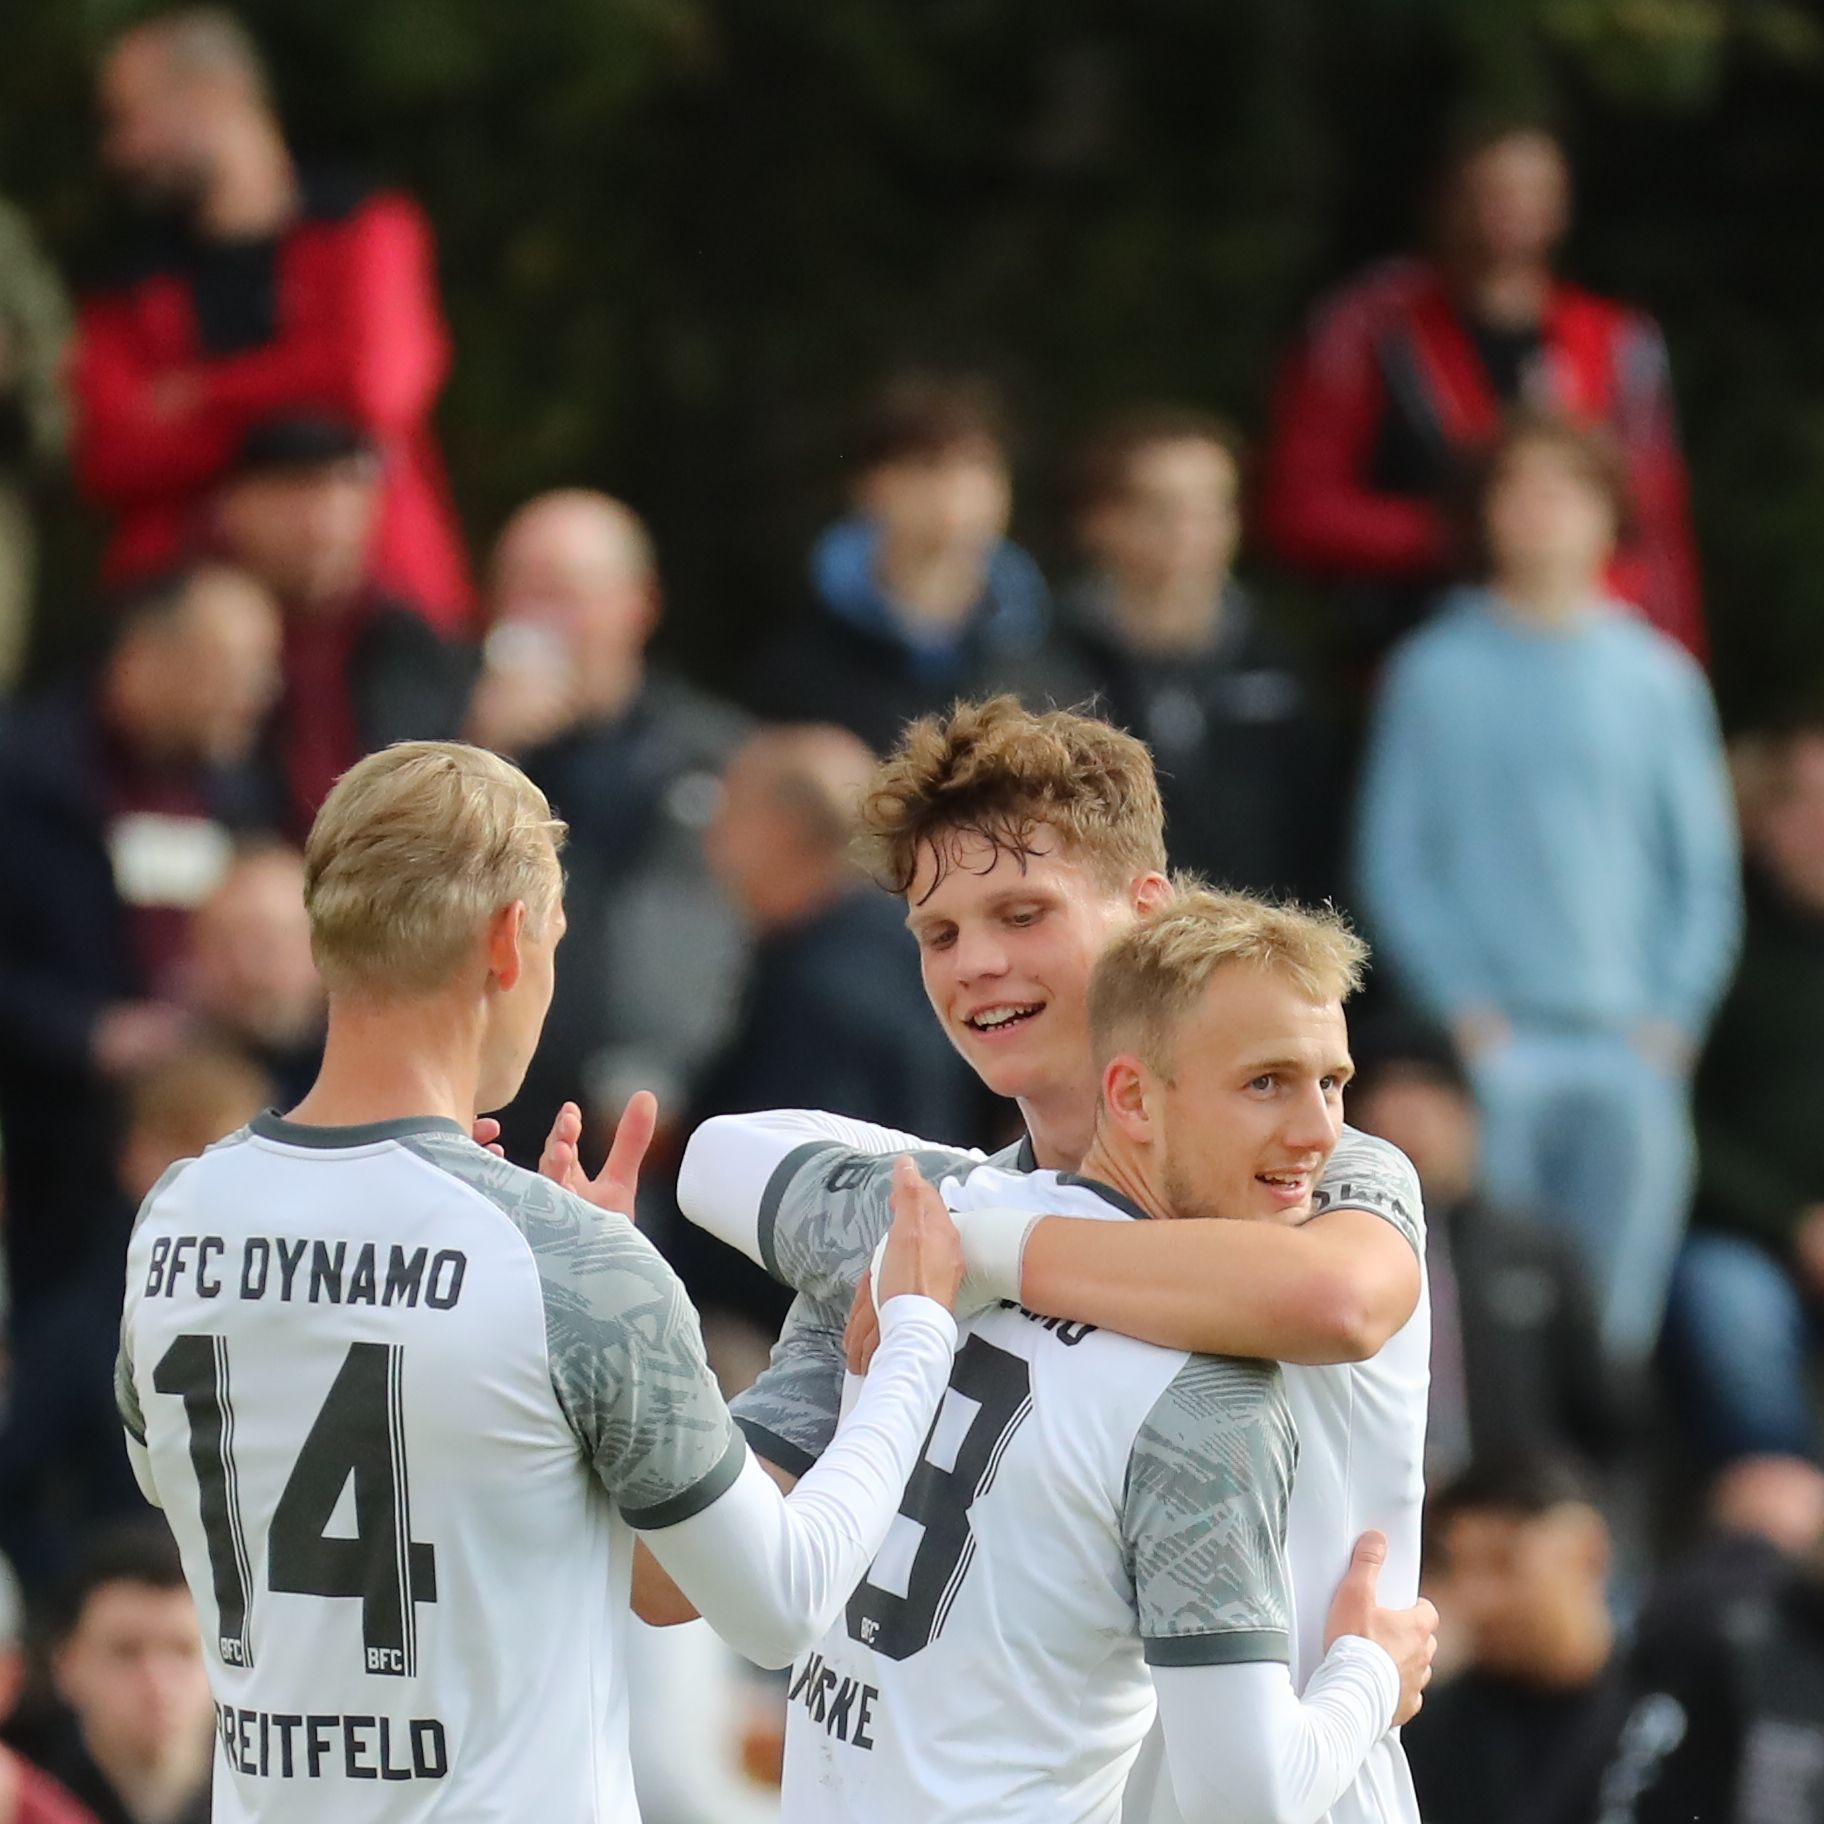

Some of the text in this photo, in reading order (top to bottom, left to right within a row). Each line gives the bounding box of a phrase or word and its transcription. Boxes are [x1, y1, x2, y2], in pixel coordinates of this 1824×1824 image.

[144, 1236, 467, 1310] BFC DYNAMO
[152, 1334, 438, 1678] 14
[367, 1646, 402, 1671] BFC
